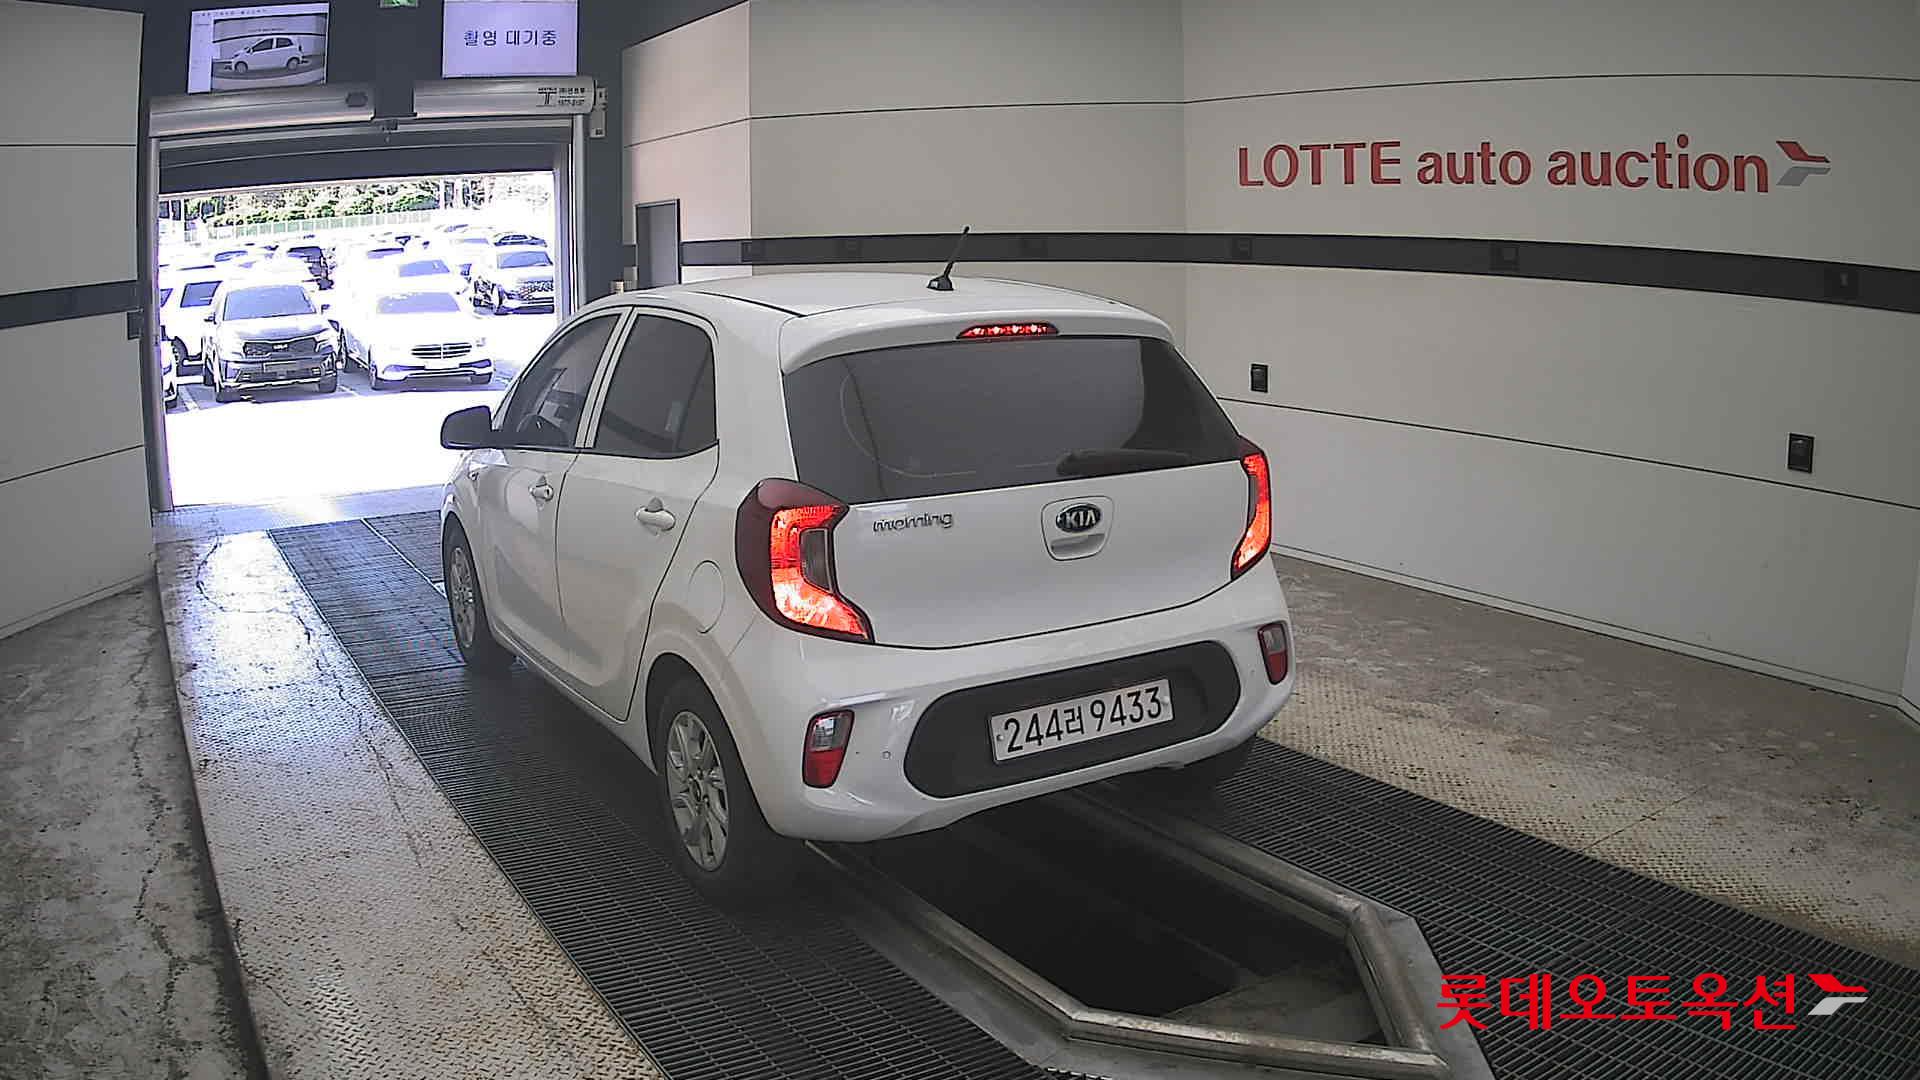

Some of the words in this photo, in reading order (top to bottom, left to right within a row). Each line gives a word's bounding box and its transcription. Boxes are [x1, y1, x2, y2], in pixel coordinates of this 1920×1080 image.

[505, 30, 557, 46] 대기중
[1239, 141, 1401, 188] LOTTE
[1416, 141, 1531, 186] auto
[1547, 134, 1768, 192] auction
[1062, 507, 1097, 529] KIA
